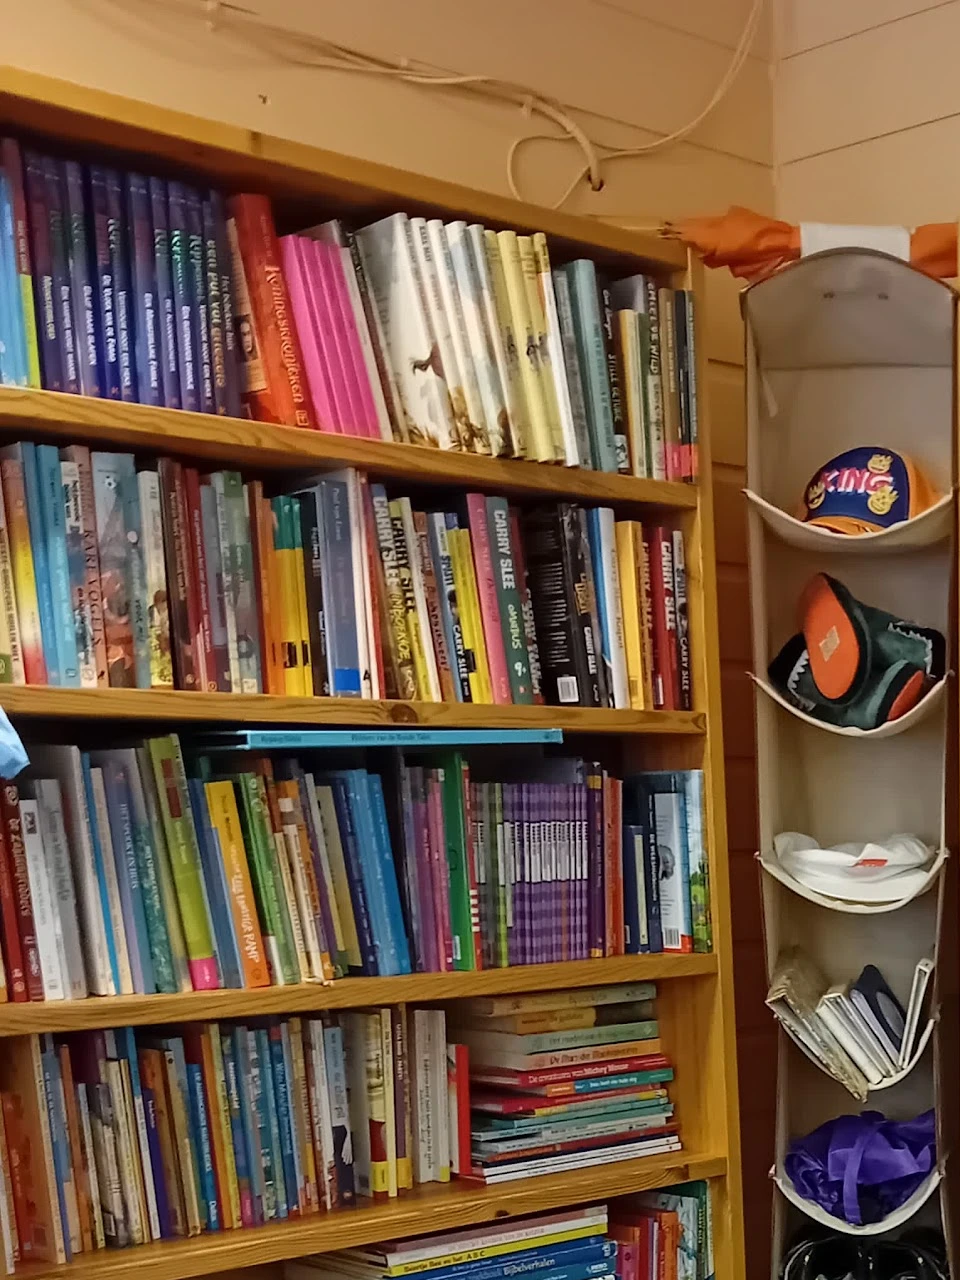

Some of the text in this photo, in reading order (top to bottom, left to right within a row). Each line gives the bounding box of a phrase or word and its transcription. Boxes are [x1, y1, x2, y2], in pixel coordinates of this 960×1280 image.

[372, 496, 392, 547] CARRY
[382, 549, 400, 586] SLEE
[494, 510, 511, 554] CARRY
[500, 559, 515, 590] SLEE
[661, 541, 676, 630] CARRY SLEE
[452, 624, 468, 679] CARRY SLEE
[587, 655, 597, 674] SLEE
[680, 637, 690, 690] CARRY SLEE
